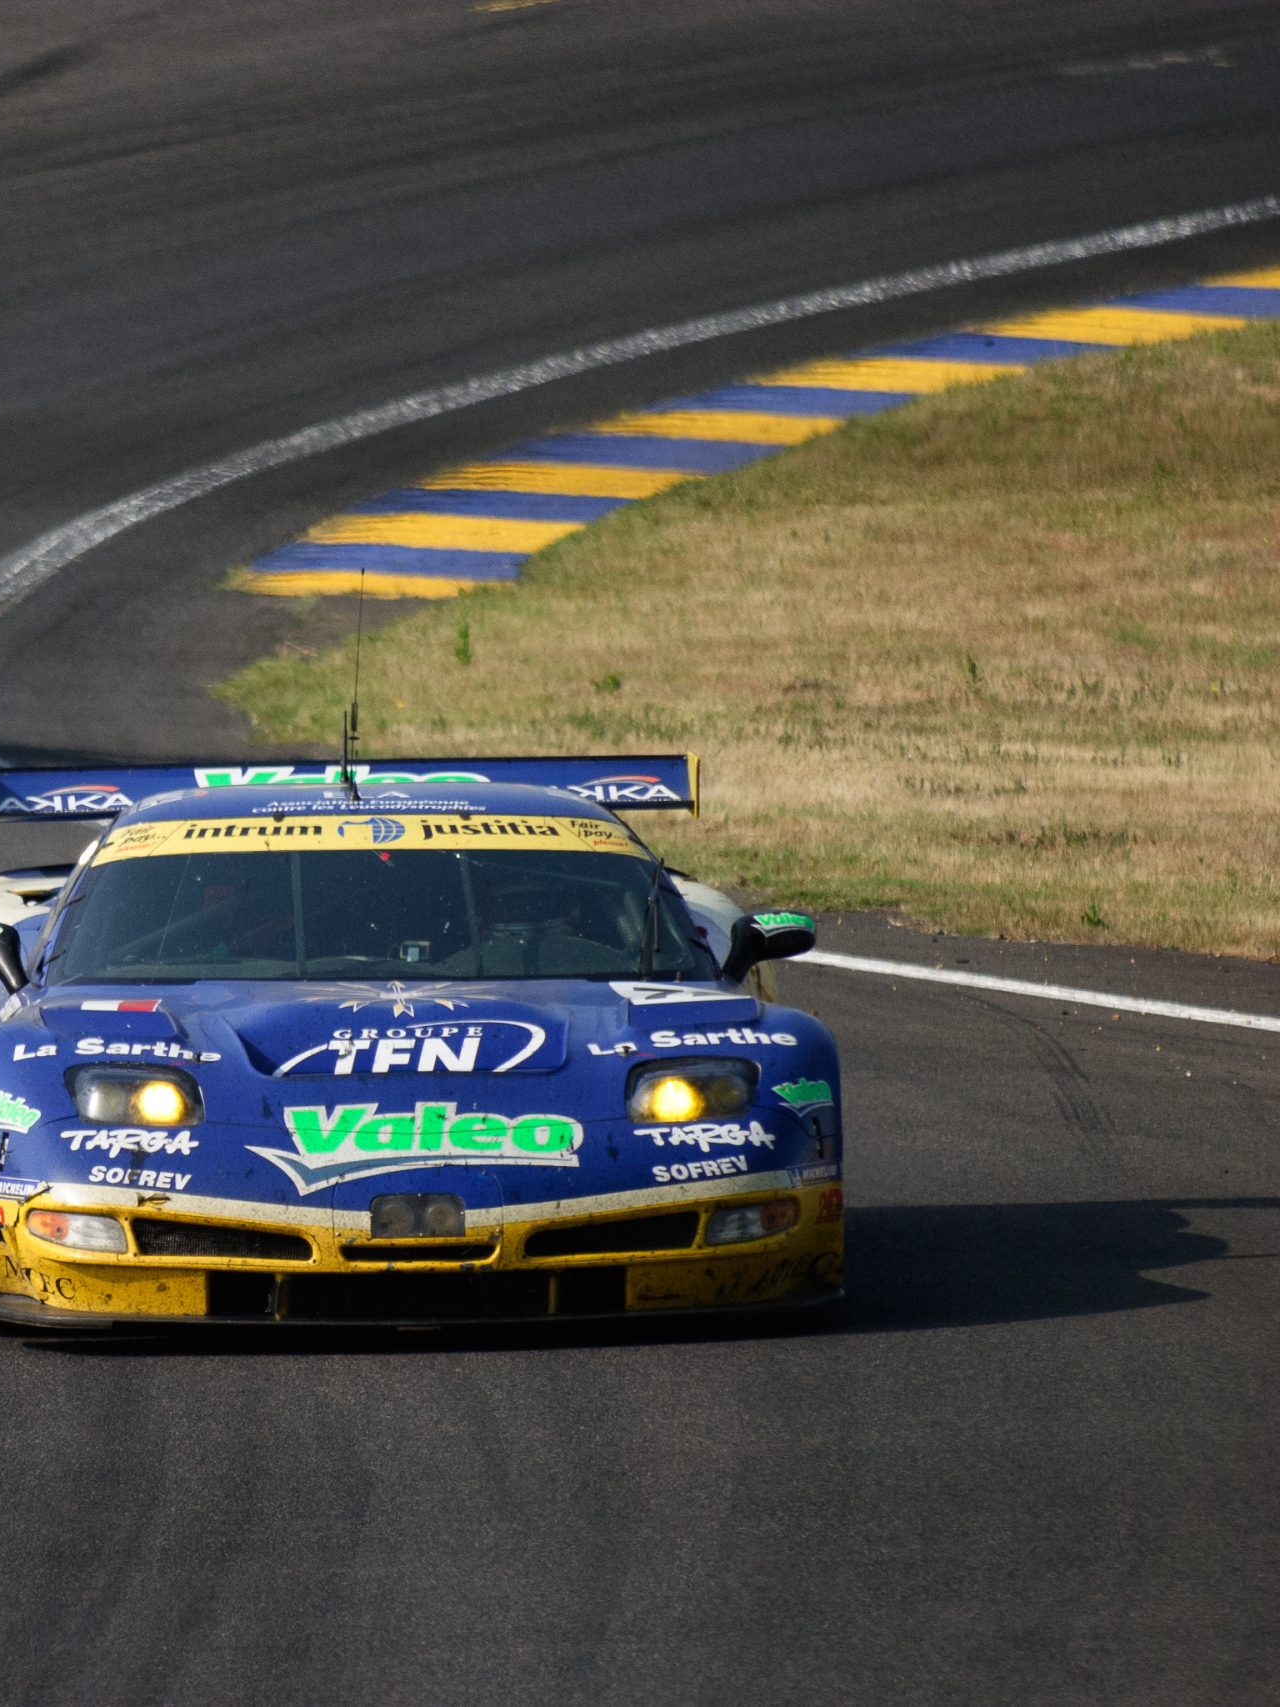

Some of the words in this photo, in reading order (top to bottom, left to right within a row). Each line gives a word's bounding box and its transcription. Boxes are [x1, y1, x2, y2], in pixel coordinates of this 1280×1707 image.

[183, 823, 322, 840] intrum
[421, 818, 560, 840] justitia
[332, 1026, 483, 1039] GROUPE
[587, 1041, 637, 1057] La
[650, 1027, 798, 1048] Sarthe
[13, 1044, 57, 1061] La
[75, 1037, 221, 1062] Sarthe
[327, 1037, 481, 1075] TFN
[286, 1102, 583, 1155] Valeo
[633, 1120, 776, 1153] TARGA
[60, 1128, 199, 1159] TARGA
[89, 1165, 192, 1190] SOFREV
[652, 1155, 748, 1182] SOFREV
